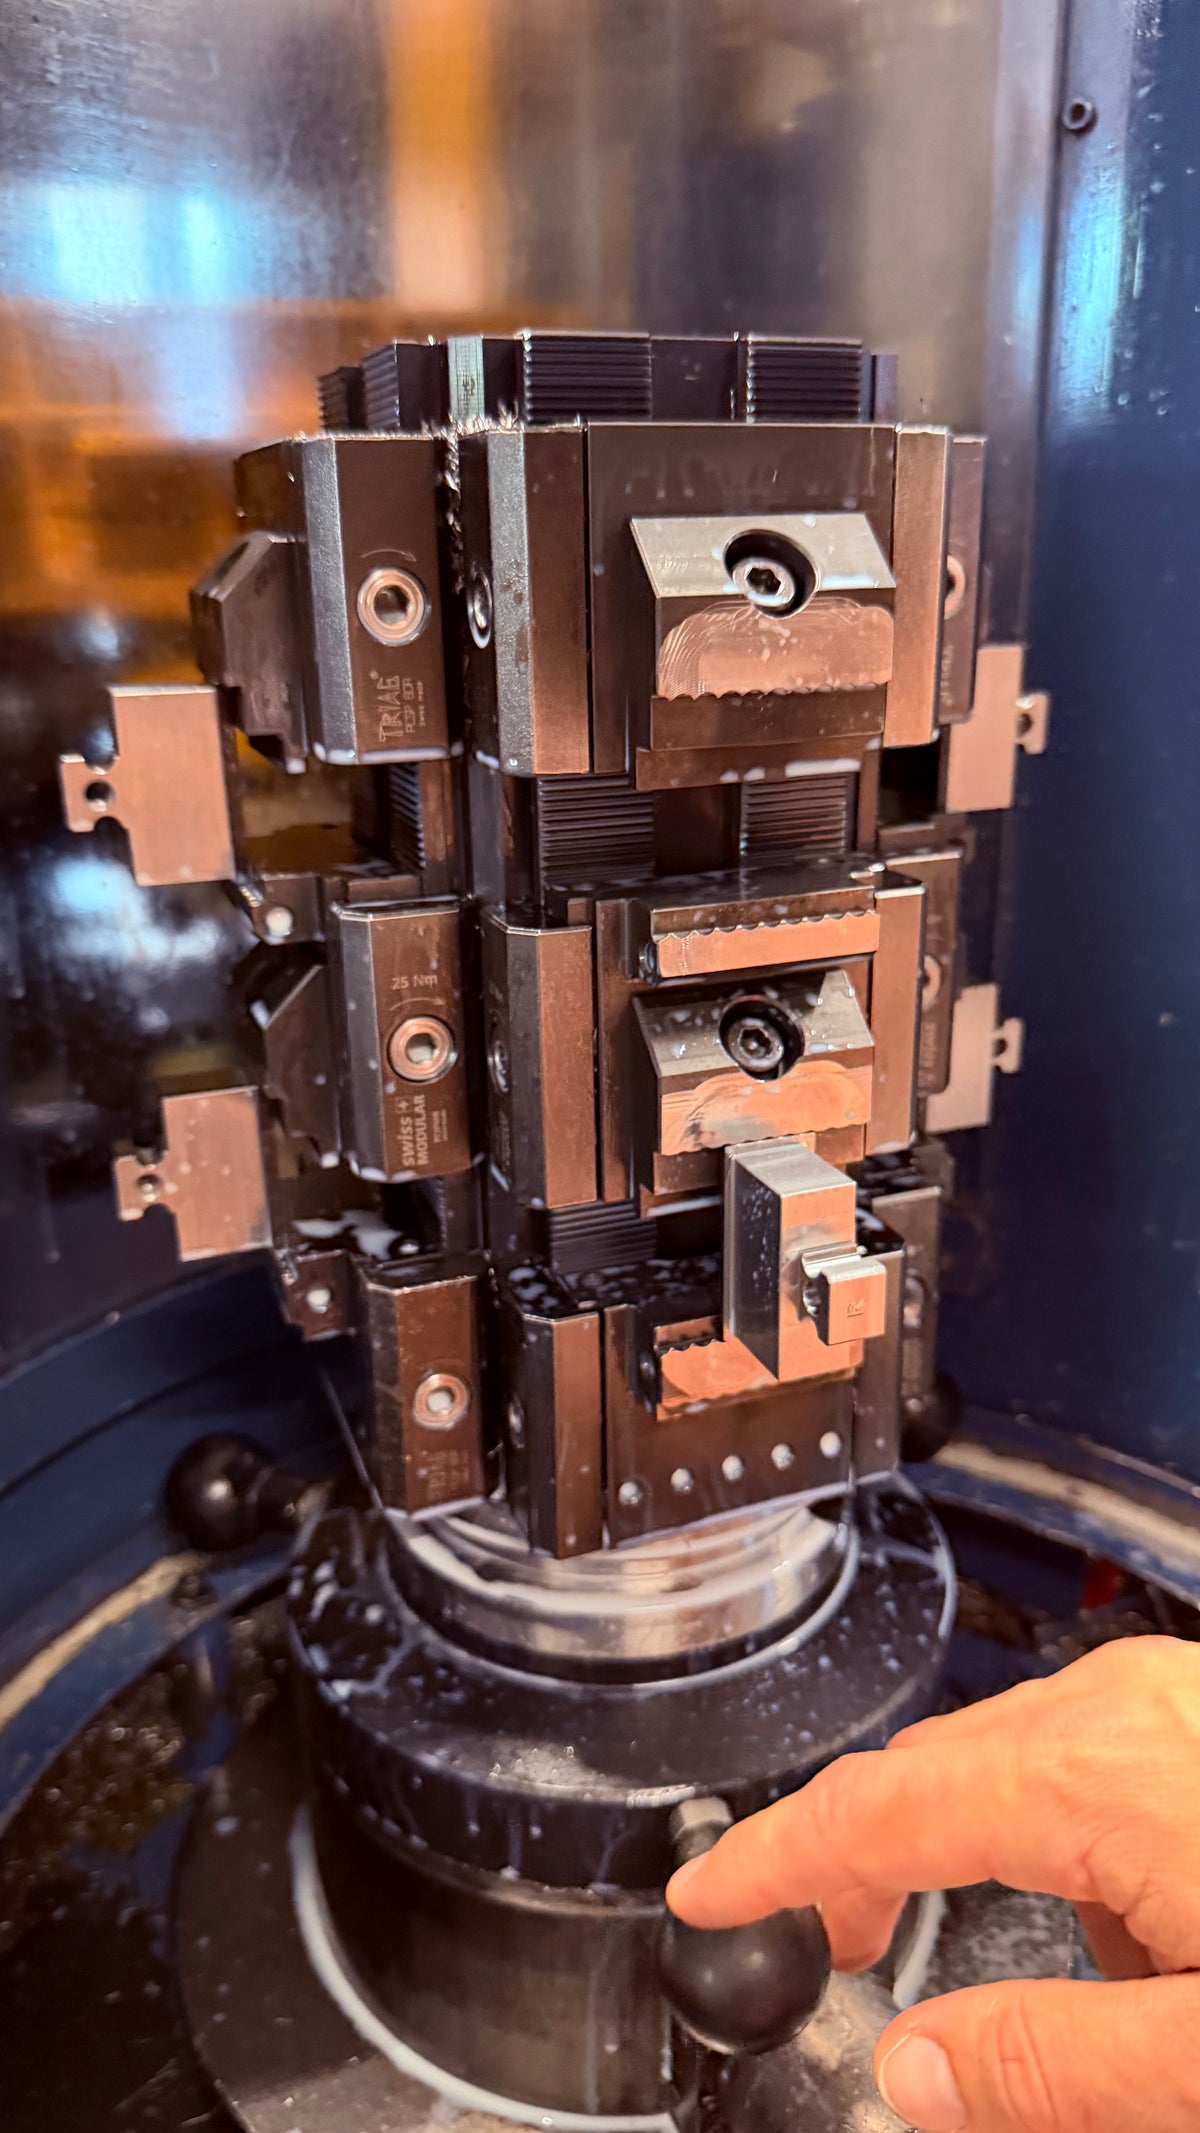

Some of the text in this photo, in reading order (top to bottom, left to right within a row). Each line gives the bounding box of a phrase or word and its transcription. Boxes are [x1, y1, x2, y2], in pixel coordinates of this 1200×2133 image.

[392, 974, 438, 990] 25 Nm
[397, 1116, 415, 1166] swiss
[414, 1094, 429, 1165] MODULAR
